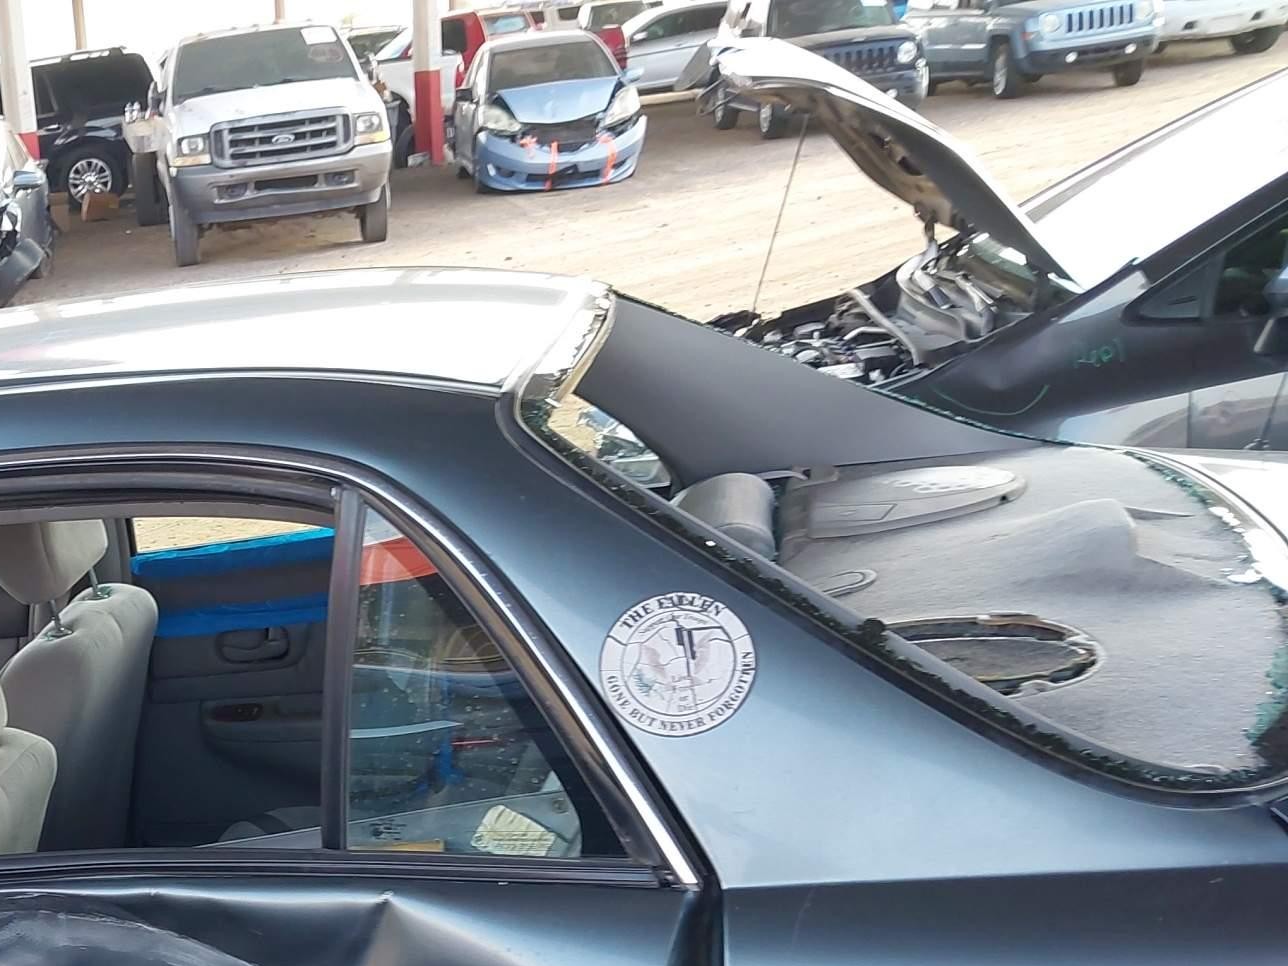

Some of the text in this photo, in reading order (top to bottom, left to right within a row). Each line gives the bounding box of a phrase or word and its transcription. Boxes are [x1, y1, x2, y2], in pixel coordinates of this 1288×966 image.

[620, 602, 654, 628] THE
[607, 675, 631, 709] GONE
[629, 708, 657, 727] BUT
[657, 717, 706, 732] NEVER
